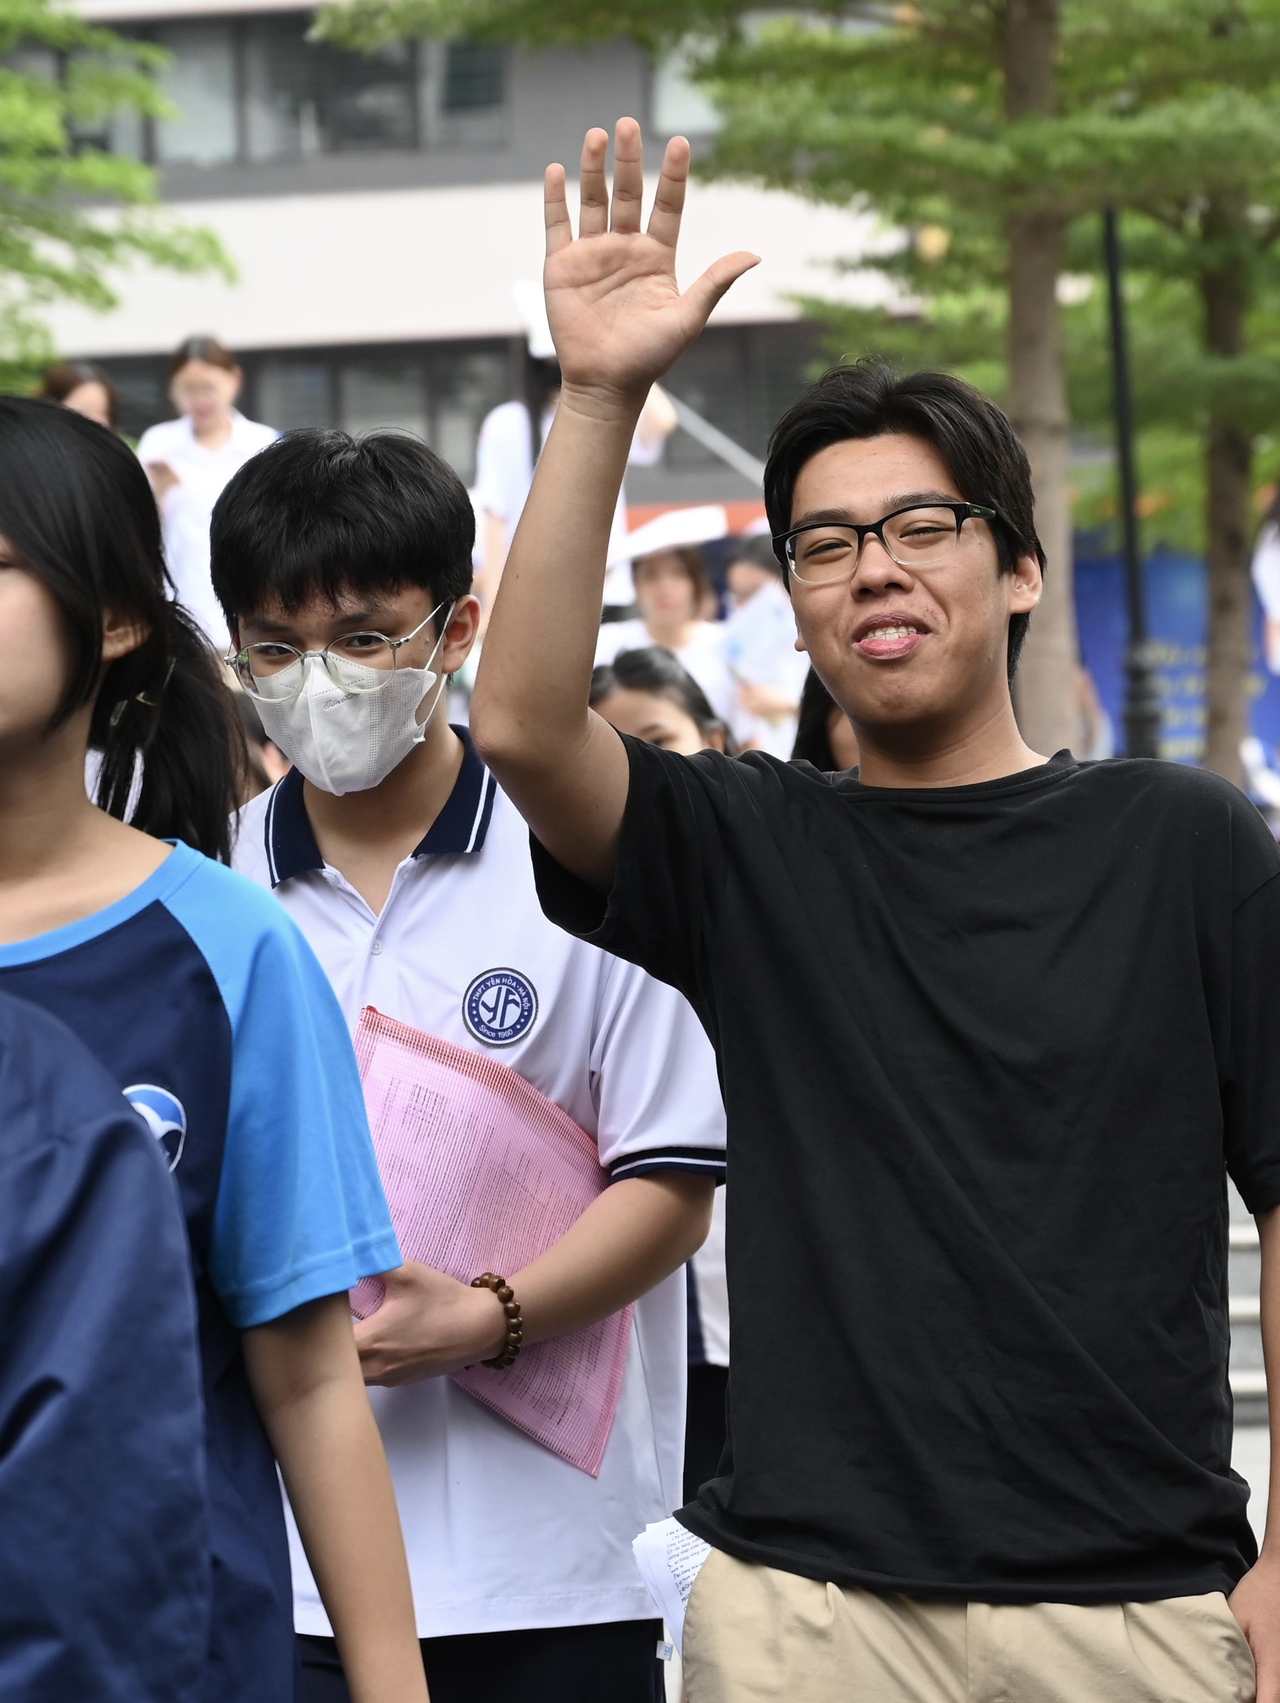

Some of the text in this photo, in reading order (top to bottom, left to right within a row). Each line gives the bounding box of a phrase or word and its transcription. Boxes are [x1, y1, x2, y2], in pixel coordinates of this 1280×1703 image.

[473, 984, 486, 1001] THPT
[486, 977, 500, 986] YÊN
[522, 997, 531, 1010] NỘI
[479, 1024, 513, 1039] Since 1960
